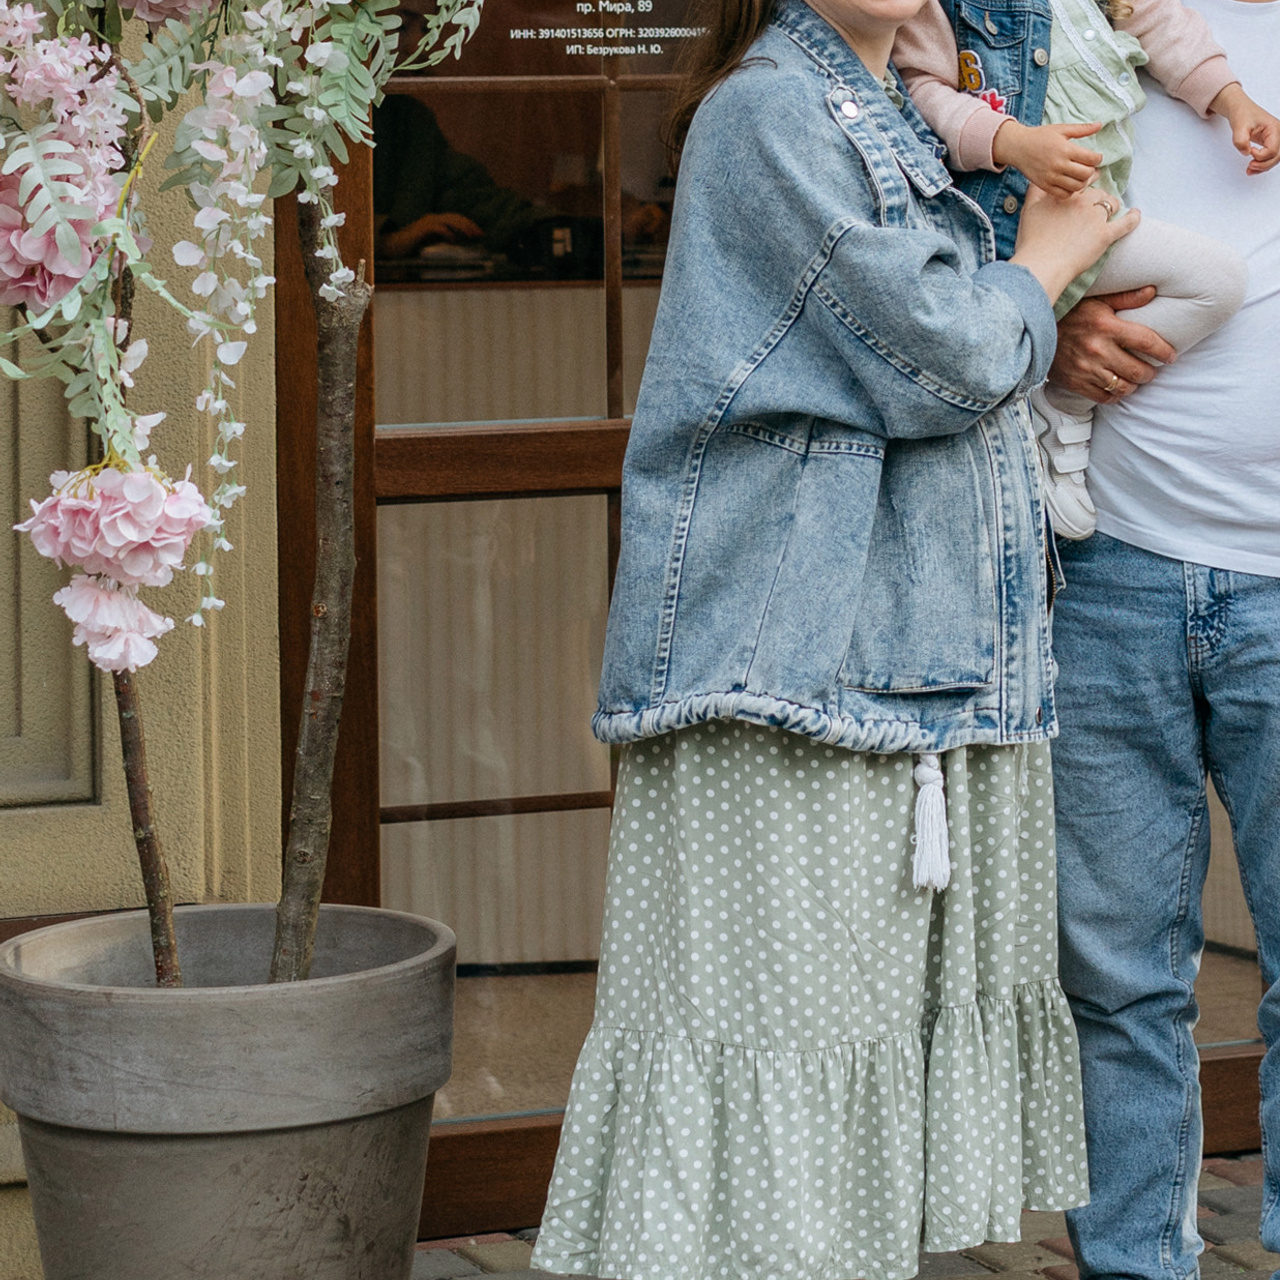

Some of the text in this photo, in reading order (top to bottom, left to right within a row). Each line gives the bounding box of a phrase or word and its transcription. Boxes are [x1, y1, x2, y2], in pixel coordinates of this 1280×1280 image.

[576, 0, 653, 15] пр. Мира, 89
[510, 28, 537, 39] ИНН:
[538, 27, 605, 39] 391401513656
[605, 27, 636, 39] ОГРН:
[566, 43, 664, 57] ИП: Безрукова Н. Ю.
